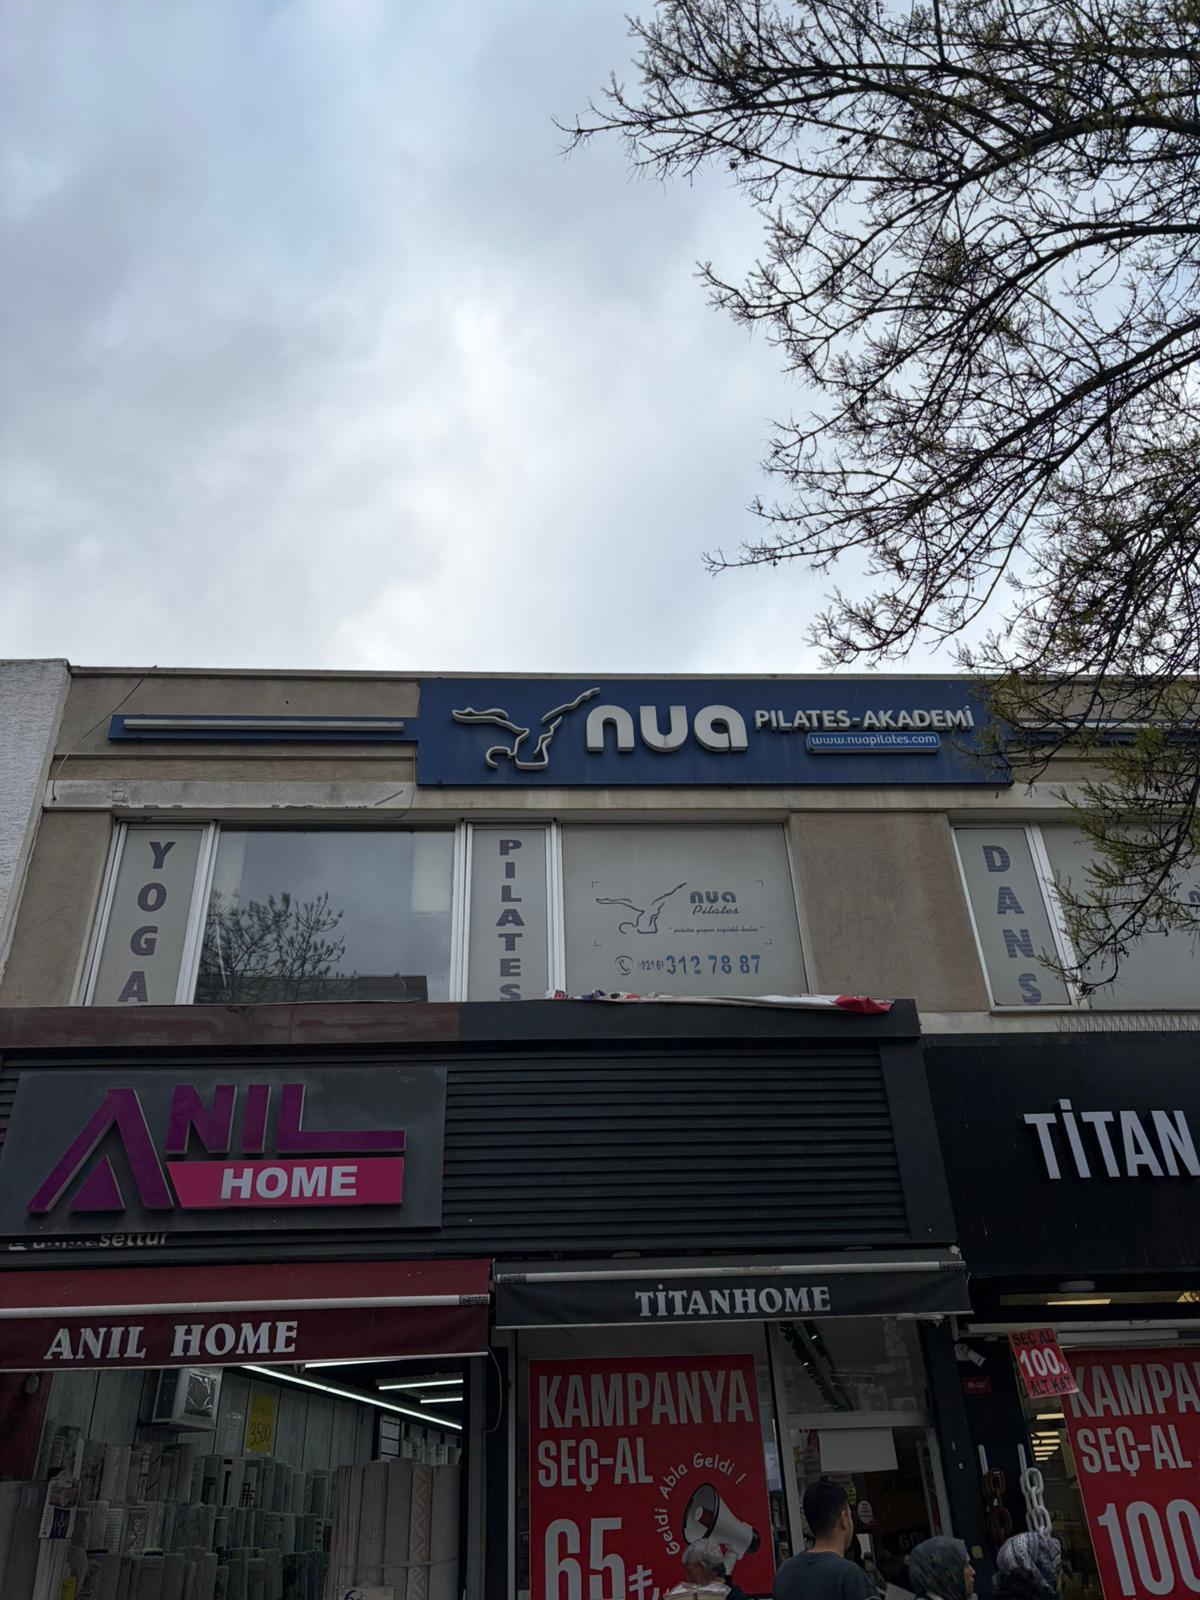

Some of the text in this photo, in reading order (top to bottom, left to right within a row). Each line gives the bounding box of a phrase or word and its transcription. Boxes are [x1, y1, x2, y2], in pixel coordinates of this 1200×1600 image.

[586, 704, 748, 752] nua
[812, 734, 937, 746] www.nuapilates.com
[118, 841, 175, 1002] YOGA
[495, 839, 525, 1000] PILATES
[690, 891, 736, 904] nua
[692, 905, 739, 914] Pilates
[982, 845, 1042, 1004] DANS
[666, 955, 701, 974] 312
[708, 955, 732, 974] 78
[739, 955, 760, 974] 87
[1023, 1098, 1200, 1180] TİTAN
[220, 1165, 358, 1199] HOME
[44, 1321, 298, 1359] ANIL HOME
[538, 1370, 753, 1428] KAMPANYA
[1069, 1361, 1200, 1418] KAMPA
[538, 1437, 653, 1491] SEÇ-AL
[693, 1452, 735, 1476] Geldi
[1076, 1424, 1193, 1477] SEÇ-AL
[659, 1463, 689, 1500] Abla
[653, 1507, 681, 1555] Geldi
[1097, 1499, 1200, 1596] 100
